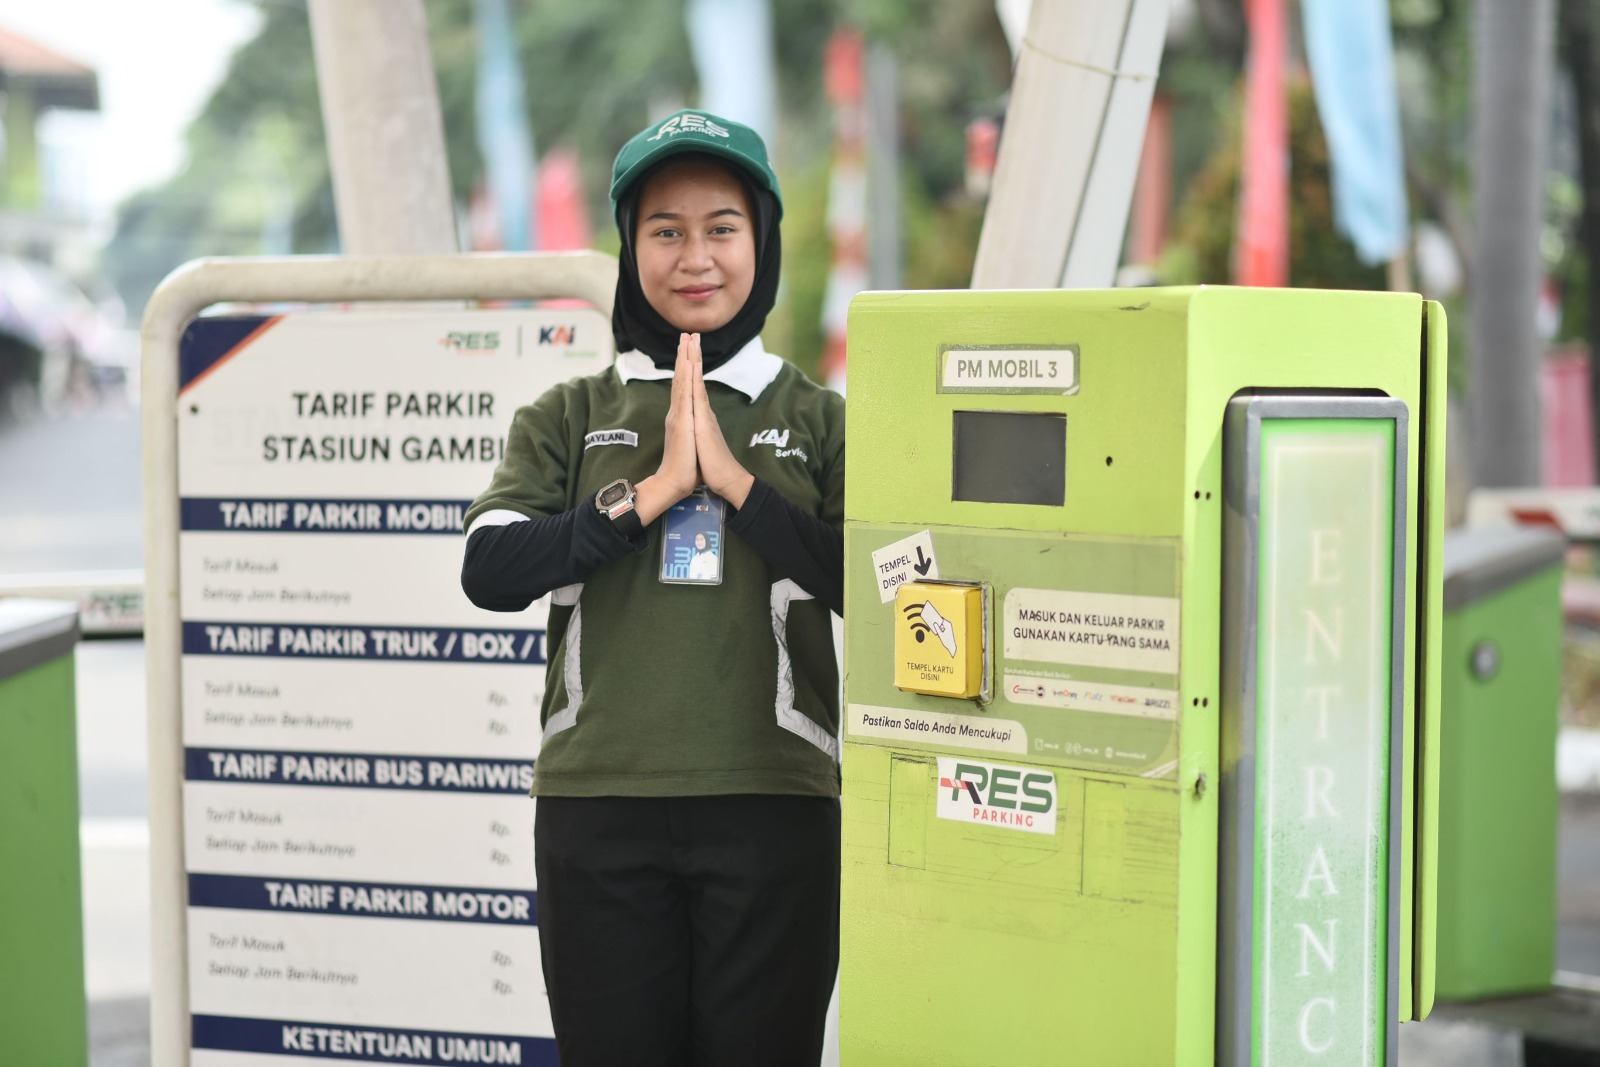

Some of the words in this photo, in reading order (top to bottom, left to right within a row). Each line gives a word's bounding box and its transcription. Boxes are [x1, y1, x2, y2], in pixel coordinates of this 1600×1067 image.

[647, 114, 729, 141] RES
[670, 127, 716, 137] PARKING
[440, 331, 501, 350] RES
[539, 325, 576, 346] KAI
[958, 360, 982, 378] PM
[989, 360, 1043, 378] MOBIL
[1048, 361, 1057, 378] 3
[293, 393, 374, 416] TARIF
[386, 393, 494, 416] PARKIR
[263, 436, 390, 461] STASIUN
[402, 437, 503, 462] GAMBI
[749, 429, 789, 447] KAI
[220, 502, 288, 527] TARIF
[294, 503, 381, 528] PARKIR
[388, 504, 462, 530] MOBIL
[879, 554, 911, 574] TEMPEL
[883, 572, 907, 589] DISINI
[1019, 609, 1056, 622] MASUK
[1060, 612, 1081, 624] DAN
[1085, 615, 1124, 627] KELUAR
[1128, 617, 1164, 630] PARKIR
[206, 626, 274, 652] TARIF
[279, 628, 365, 654] PARKIR
[371, 631, 438, 656] TRUK
[462, 633, 515, 658] BOX
[1014, 627, 1065, 641] GUNAKAN
[1070, 632, 1104, 645] KARTU
[1106, 634, 1135, 648] YANG
[1139, 637, 1170, 650] SAMA
[907, 663, 931, 671] TEMPEL
[933, 665, 954, 674] KARTU
[921, 673, 941, 681] DISINI
[863, 714, 901, 728] Pastikan
[904, 719, 929, 731] Saldo
[932, 722, 956, 734] Anda
[959, 724, 1011, 742] Mencukupi
[209, 754, 276, 779] TARIF
[283, 756, 368, 783] PARKIR
[375, 760, 423, 785] BUS
[428, 761, 533, 789] PARIWIS
[941, 764, 1053, 813] RES
[973, 808, 1033, 827] PARKING
[265, 883, 335, 908] TARIF
[340, 887, 427, 914] PARKIR
[434, 894, 529, 919] MOTOR
[283, 1027, 431, 1058] KETENTUAN
[438, 1034, 521, 1065] UMUM
